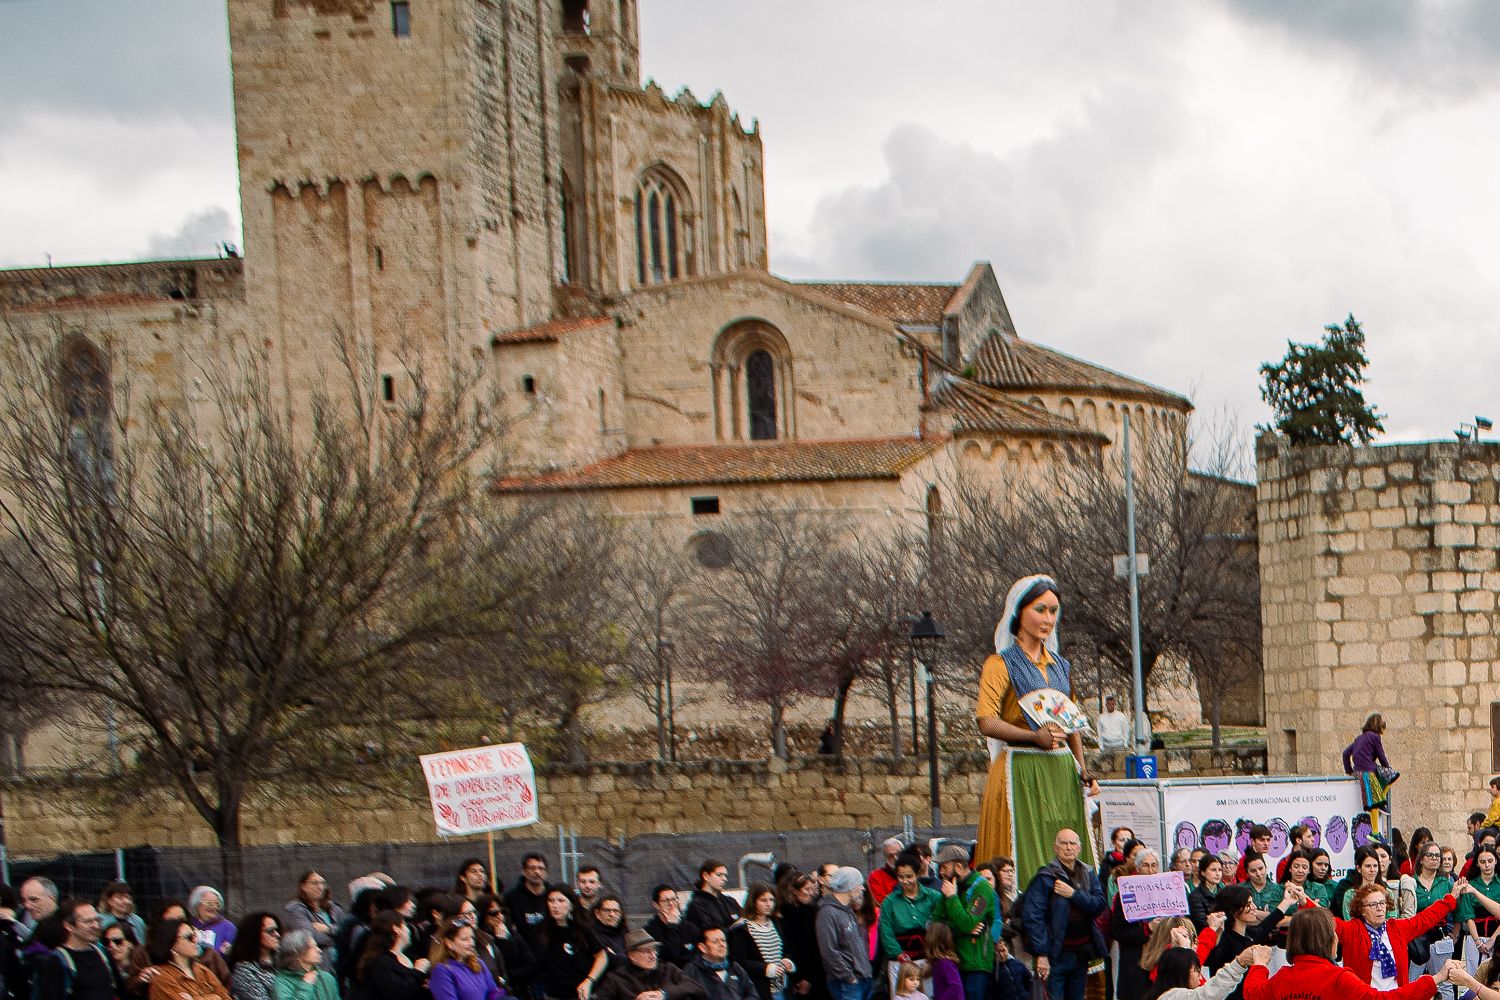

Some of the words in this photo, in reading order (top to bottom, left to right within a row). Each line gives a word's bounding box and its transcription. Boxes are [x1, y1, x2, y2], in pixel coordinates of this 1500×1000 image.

[1227, 798, 1239, 806] DIA
[1240, 796, 1291, 806] INTERNACIONAL
[1302, 795, 1314, 803] LES
[1315, 794, 1337, 802] DONES
[1121, 880, 1172, 893] Feminista
[1126, 898, 1185, 915] Anticapitalista
